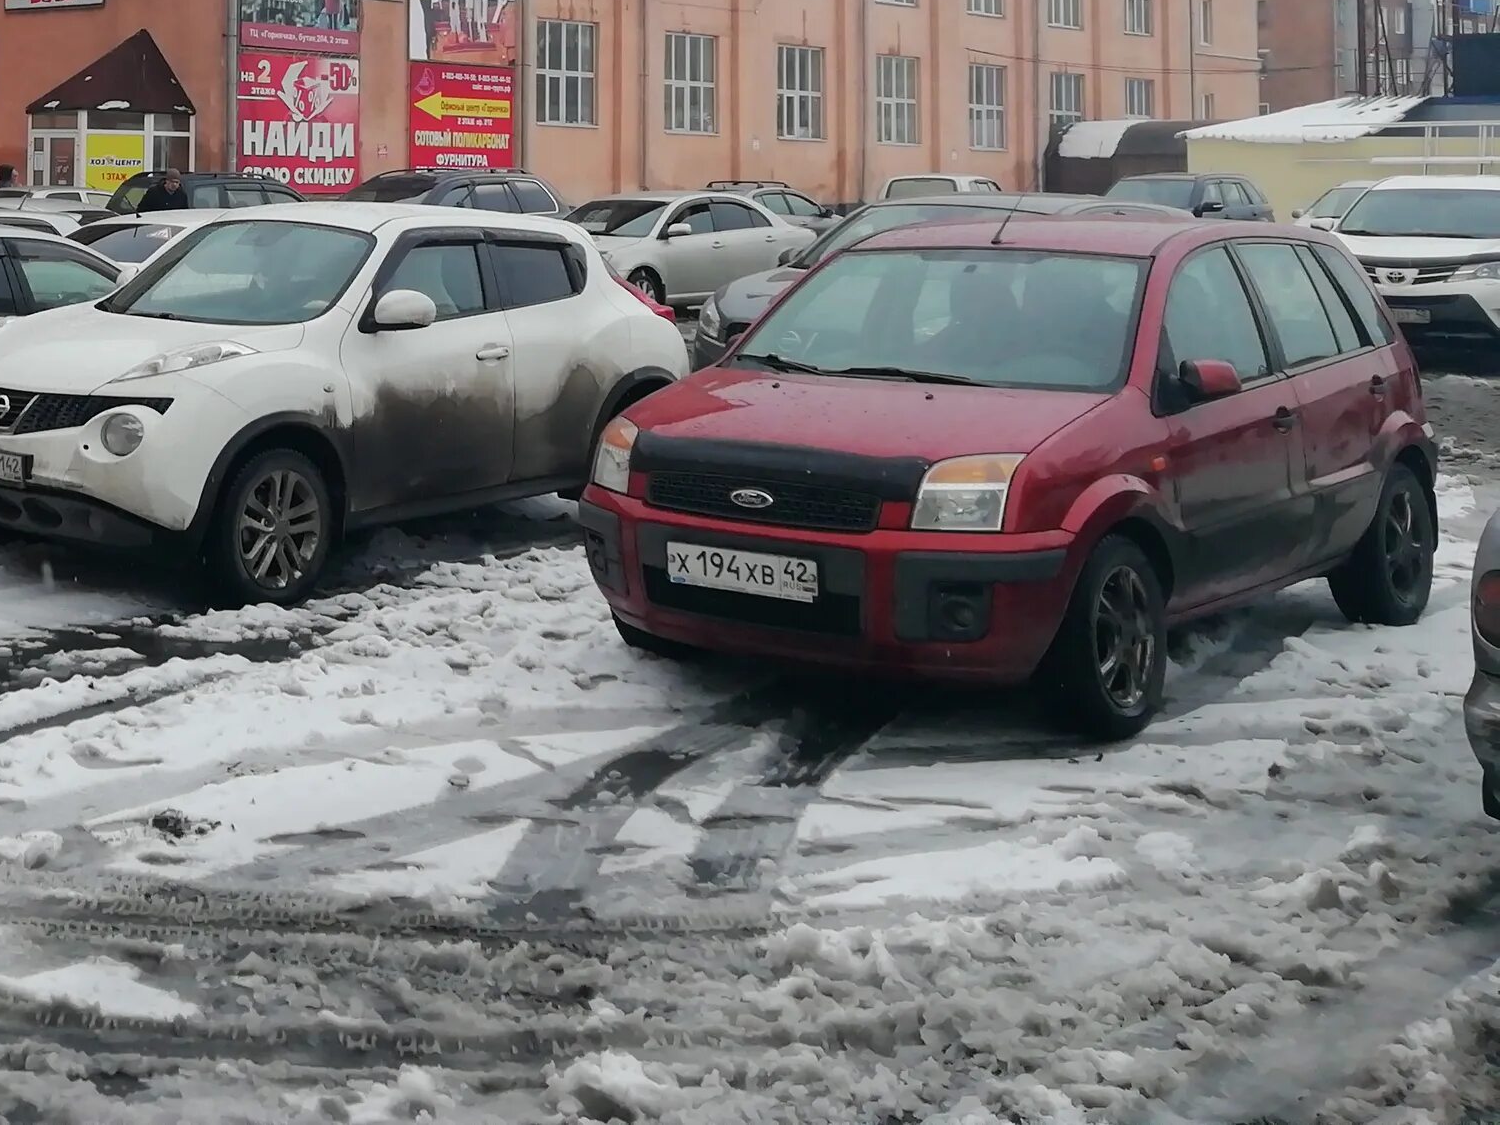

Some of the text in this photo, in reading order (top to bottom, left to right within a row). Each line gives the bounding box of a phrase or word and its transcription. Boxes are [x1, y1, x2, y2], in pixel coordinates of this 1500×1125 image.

[240, 71, 254, 82] на
[257, 59, 271, 83] 2
[251, 86, 276, 95] этаже
[243, 117, 354, 163] НАЙДИ
[415, 128, 510, 149] СОТОВЫЙ ПОЛИКАРБОНАТ
[436, 153, 488, 166] ФУРНИТУРА
[106, 173, 127, 181] ЭТАЖ
[293, 167, 355, 187] СКИДКУ
[783, 560, 808, 583] 42
